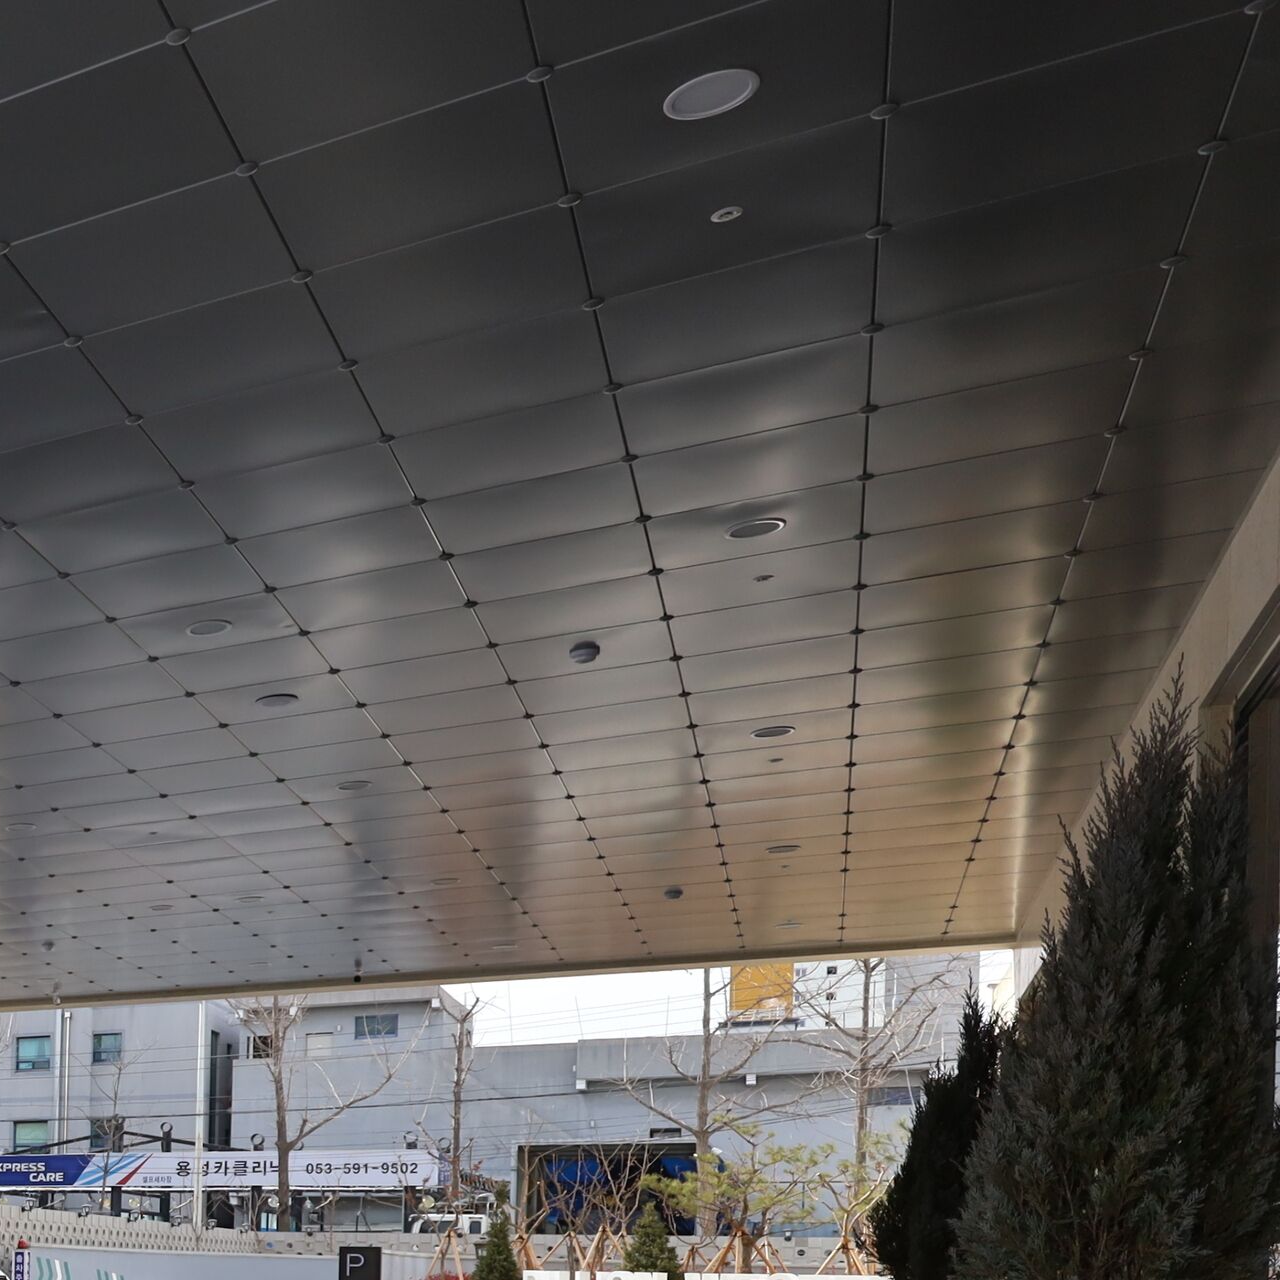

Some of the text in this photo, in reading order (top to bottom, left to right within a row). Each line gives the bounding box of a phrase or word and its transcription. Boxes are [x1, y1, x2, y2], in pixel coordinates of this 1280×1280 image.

[306, 1162, 418, 1175] 053-591-9502
[29, 1172, 64, 1182] CARE
[346, 1253, 365, 1277] P
